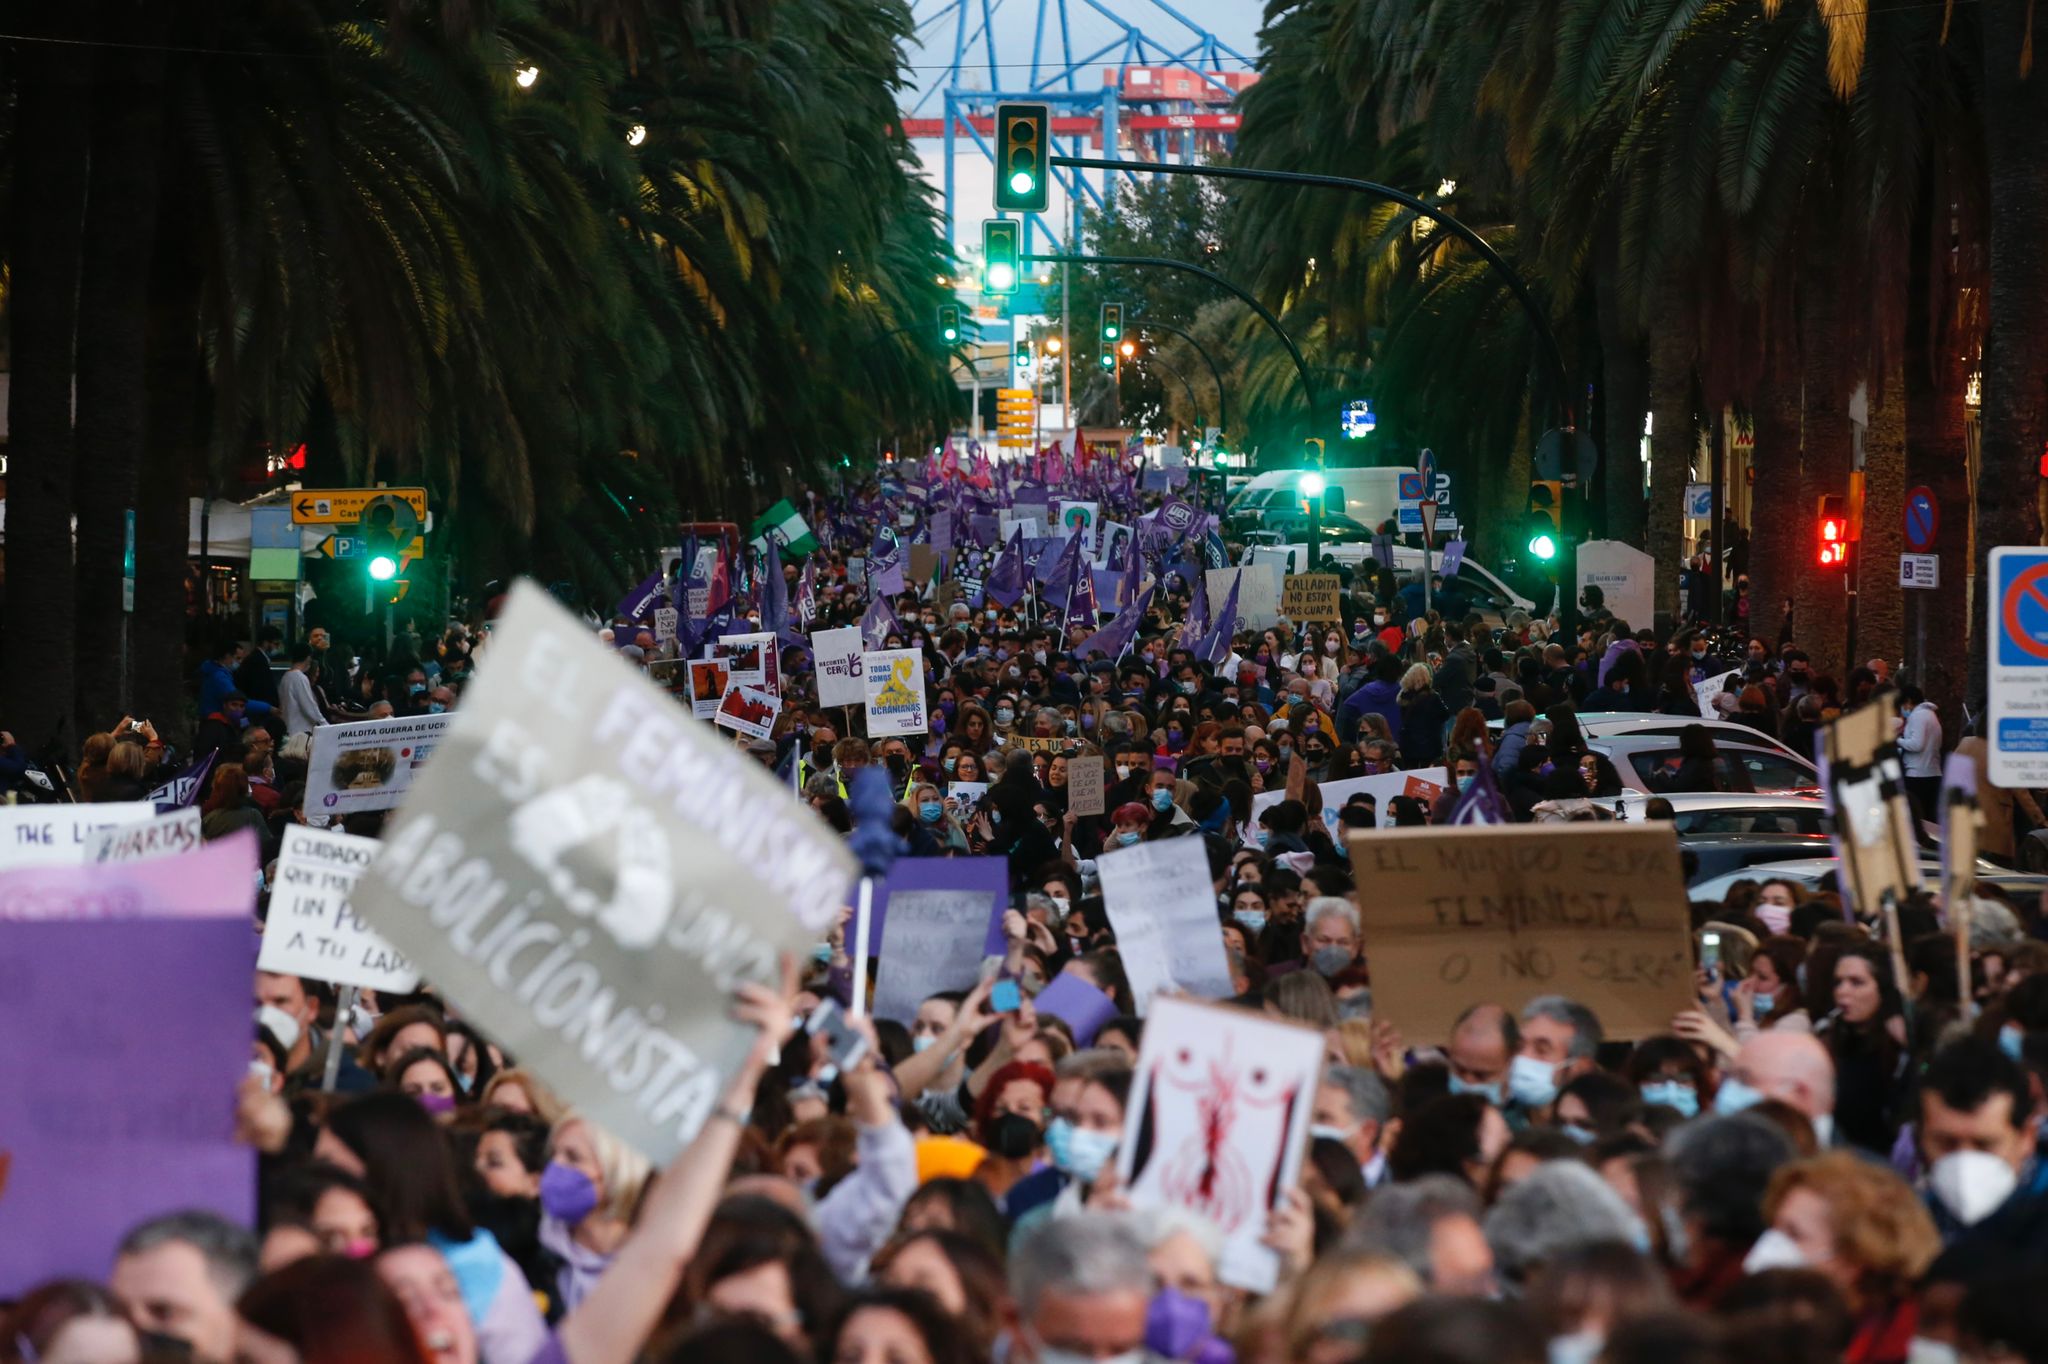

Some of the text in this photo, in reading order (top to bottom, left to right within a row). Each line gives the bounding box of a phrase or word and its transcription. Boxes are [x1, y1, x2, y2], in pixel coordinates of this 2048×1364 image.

[340, 510, 361, 518] Cast
[339, 540, 350, 555] P
[1284, 578, 1338, 590] CALLADITA
[1290, 592, 1331, 602] NO ESTOY
[870, 664, 891, 674] TODAS
[868, 673, 892, 683] SOMOS
[870, 703, 921, 716] UCRANIANAS
[379, 723, 413, 735] GUERRA
[414, 723, 426, 732] DE
[1029, 739, 1040, 751] ES
[594, 684, 853, 931] FEMINISMO
[15, 824, 54, 844] THE
[291, 837, 372, 866] CUIDADO
[1374, 846, 1419, 872] EL
[286, 931, 305, 950] A
[316, 936, 347, 959] TU
[1438, 951, 1471, 985] O
[1500, 947, 1556, 981] NO
